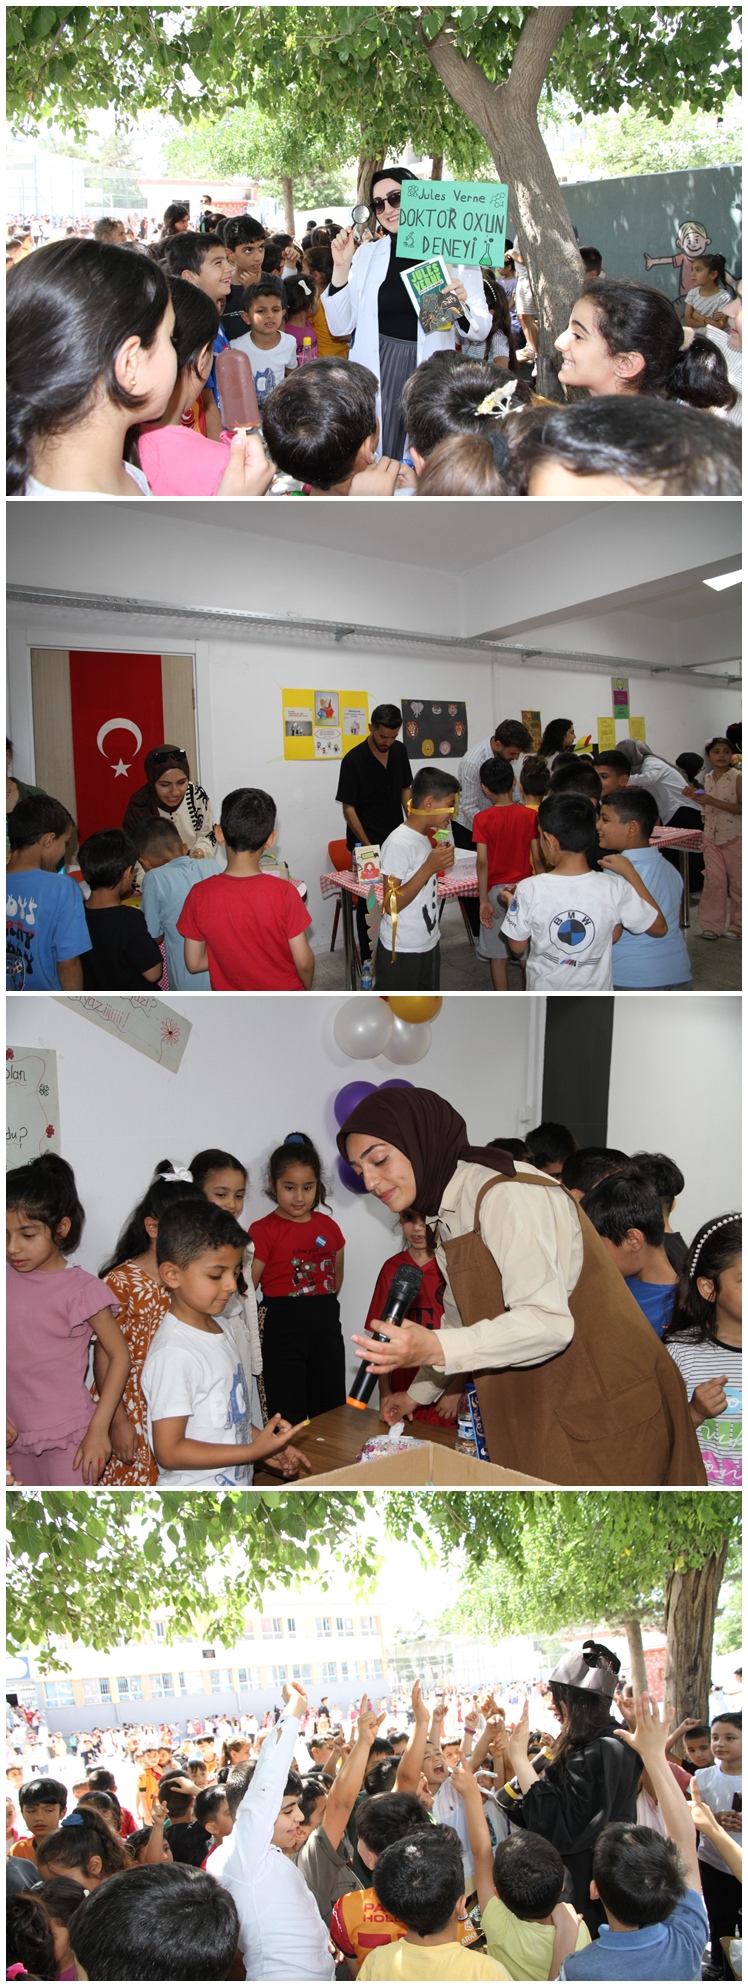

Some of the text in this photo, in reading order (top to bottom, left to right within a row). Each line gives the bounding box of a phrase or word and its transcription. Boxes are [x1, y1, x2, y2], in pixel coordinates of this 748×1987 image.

[418, 188, 486, 203] Jules Verne
[399, 208, 457, 230] DOKTOR
[411, 263, 440, 282] JULES
[413, 272, 442, 292] VERNE
[554, 911, 592, 926] BMW
